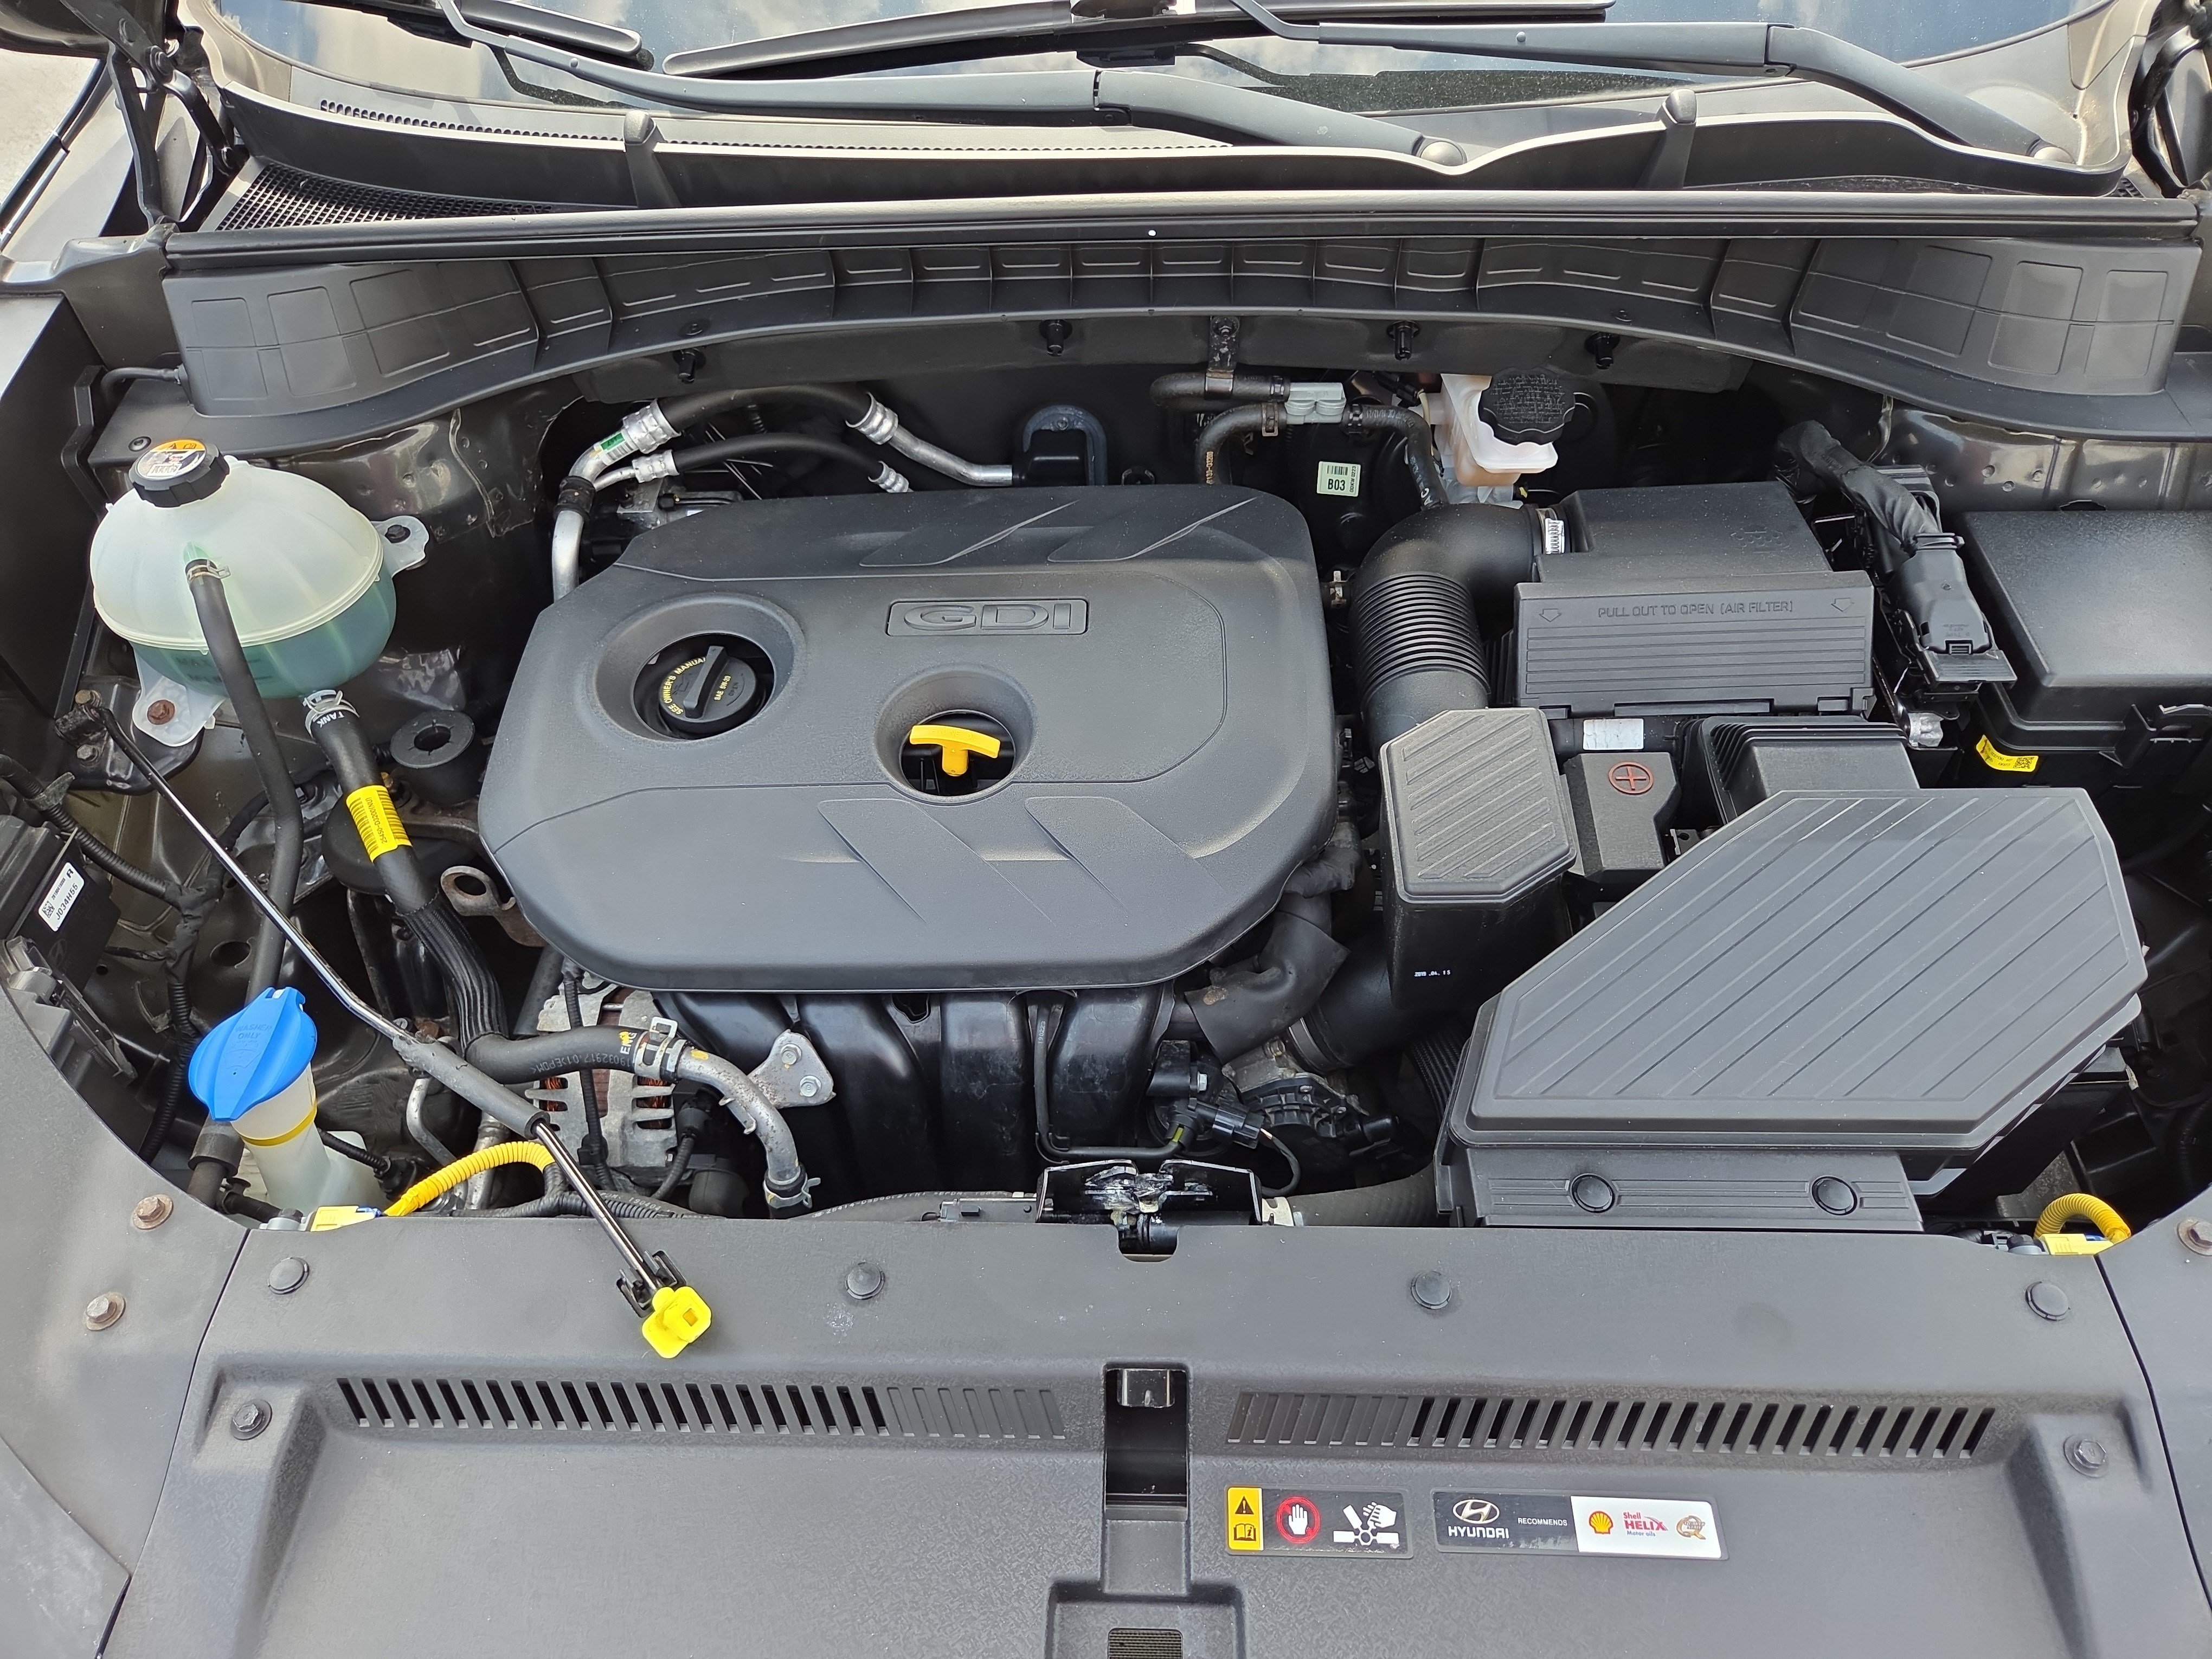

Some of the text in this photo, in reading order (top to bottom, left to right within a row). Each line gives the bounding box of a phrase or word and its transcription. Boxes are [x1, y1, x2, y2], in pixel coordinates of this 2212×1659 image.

[1328, 479, 1345, 491] B03
[1599, 607, 1629, 618] PULL
[1632, 605, 1657, 616] OUT
[1661, 605, 1676, 615] TO
[1680, 603, 1714, 614] OPEN
[904, 603, 1071, 631] GDI
[663, 675, 677, 704] OWNER'S
[714, 690, 724, 700] SAE
[667, 703, 684, 715] SEE
[316, 711, 345, 728] TANK
[66, 868, 74, 879] R
[55, 883, 78, 921] J034H55
[1517, 1517, 1568, 1527] RECOMMENDS
[1623, 1512, 1641, 1520] Shell
[1624, 1519, 1668, 1531] HELIX
[1448, 1526, 1510, 1539] HYUNDAI
